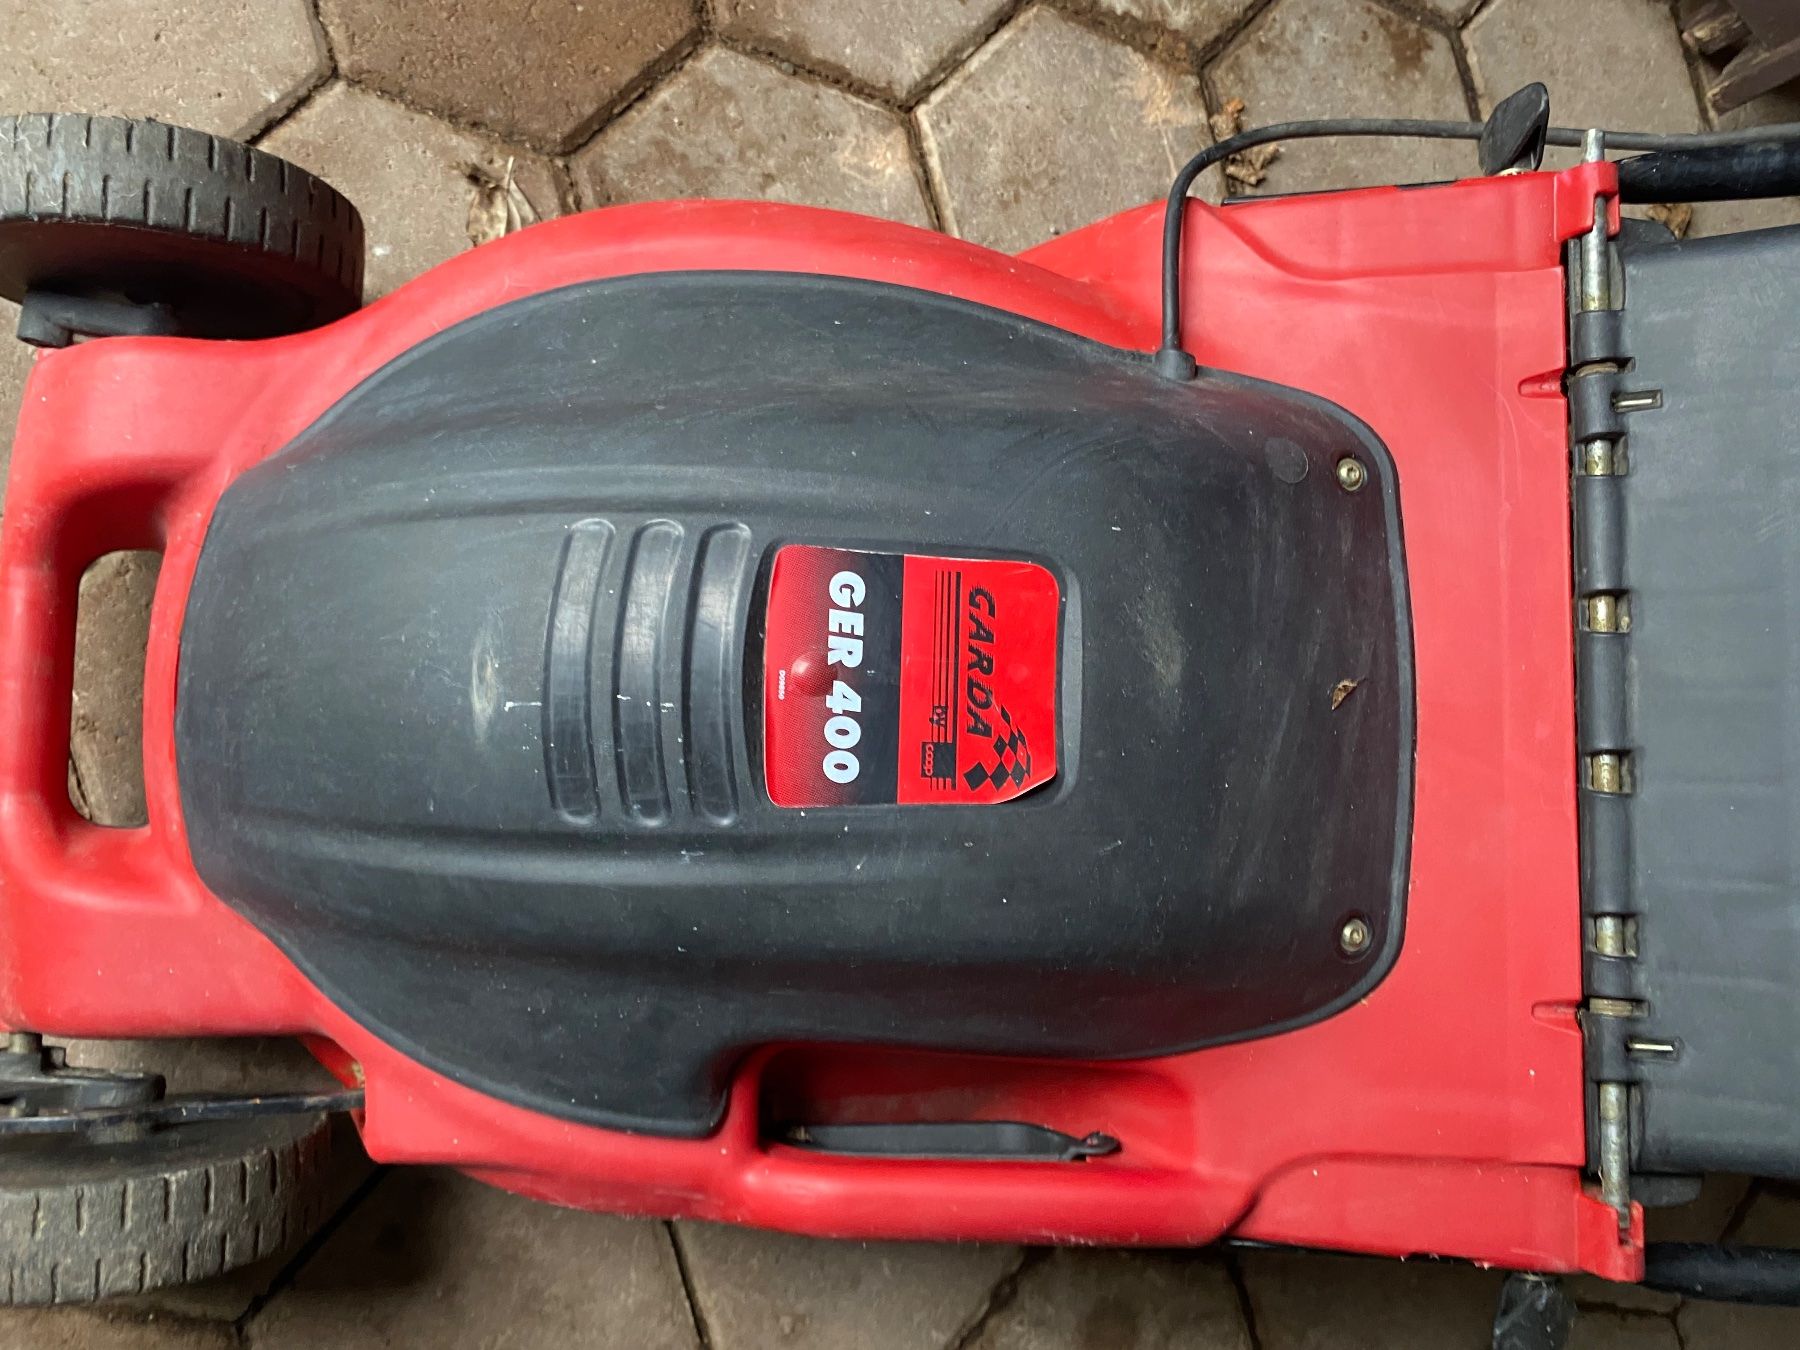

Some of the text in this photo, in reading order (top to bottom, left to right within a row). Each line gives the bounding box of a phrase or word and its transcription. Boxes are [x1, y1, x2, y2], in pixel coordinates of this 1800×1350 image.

[822, 570, 866, 784] GER 400
[966, 584, 996, 738] GARDA
[923, 743, 935, 777] coop
